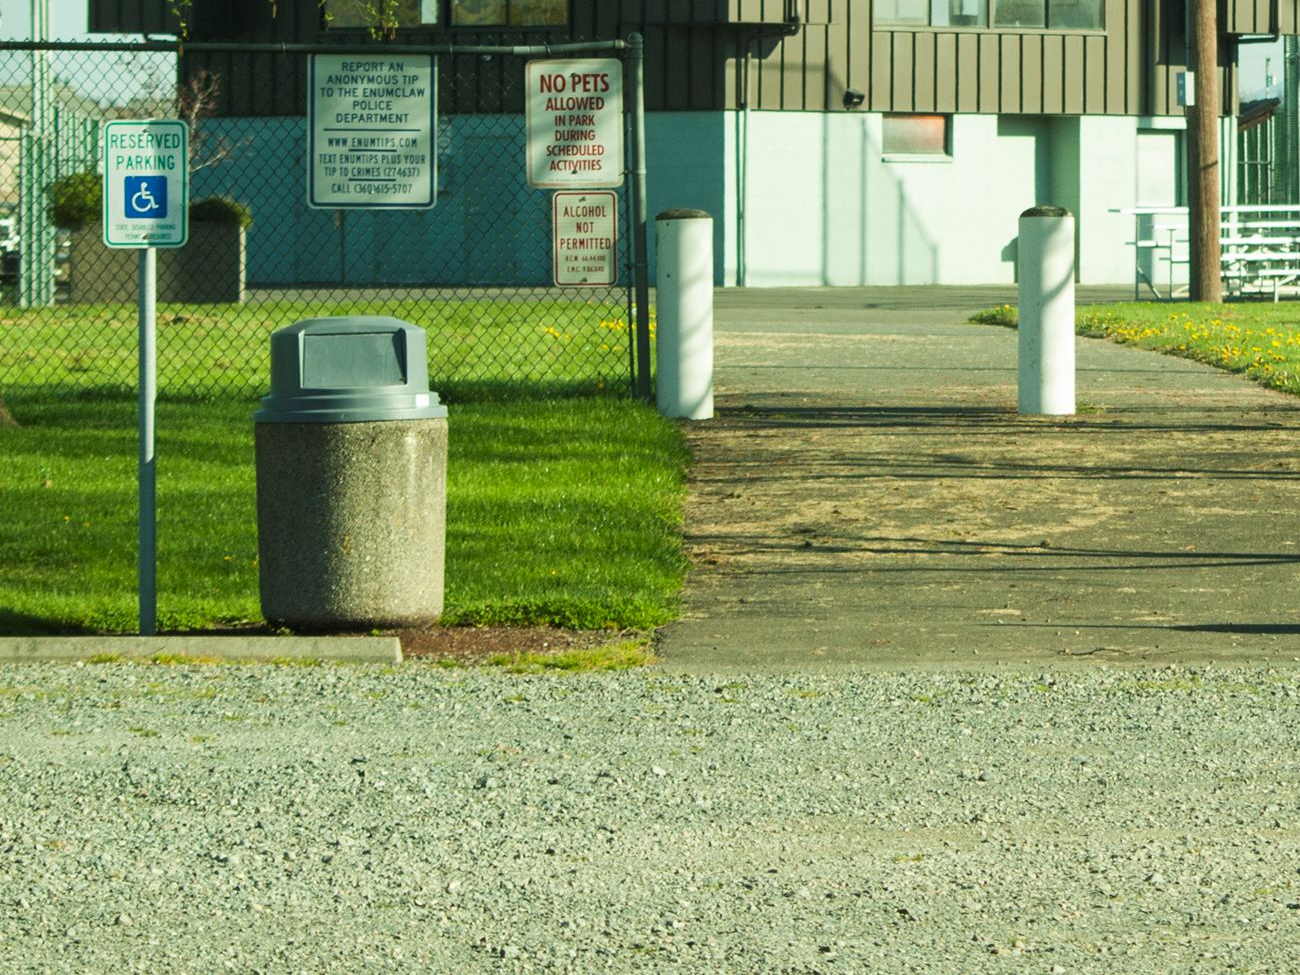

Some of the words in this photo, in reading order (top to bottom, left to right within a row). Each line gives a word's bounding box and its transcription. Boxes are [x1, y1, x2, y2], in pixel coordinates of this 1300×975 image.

[341, 62, 384, 72] REPORT
[388, 62, 404, 72] AN
[326, 75, 398, 85] ANONYMOUS
[402, 75, 419, 85] TIP
[540, 74, 566, 94] NO
[571, 73, 610, 93] PETS
[320, 88, 334, 98] TO
[338, 88, 359, 98] THE
[362, 88, 425, 98] ENUMCLAW
[352, 101, 393, 111] POLICE
[545, 97, 605, 111] ALLOWED
[336, 113, 409, 123] DEPARTMENT
[555, 115, 566, 126] IN
[569, 115, 595, 126] PARK
[110, 133, 180, 149] RESERVED
[555, 130, 596, 141] DURING
[546, 145, 605, 157] SCHEDULED
[116, 155, 175, 170] PARKING
[319, 154, 337, 164] TEXT
[340, 154, 379, 164] ENUMTIPS
[381, 154, 401, 164] PLUS
[403, 154, 426, 164] YOUR
[549, 160, 602, 171] ACTIVITIES
[324, 167, 337, 177] TIP
[340, 167, 349, 177] TO
[351, 167, 381, 177] CRIMES
[383, 167, 420, 178] (274637)
[331, 183, 351, 194] CALL
[563, 206, 607, 218] ALCOHOL
[576, 222, 594, 234] NOT
[560, 238, 611, 250] PERMITTED
